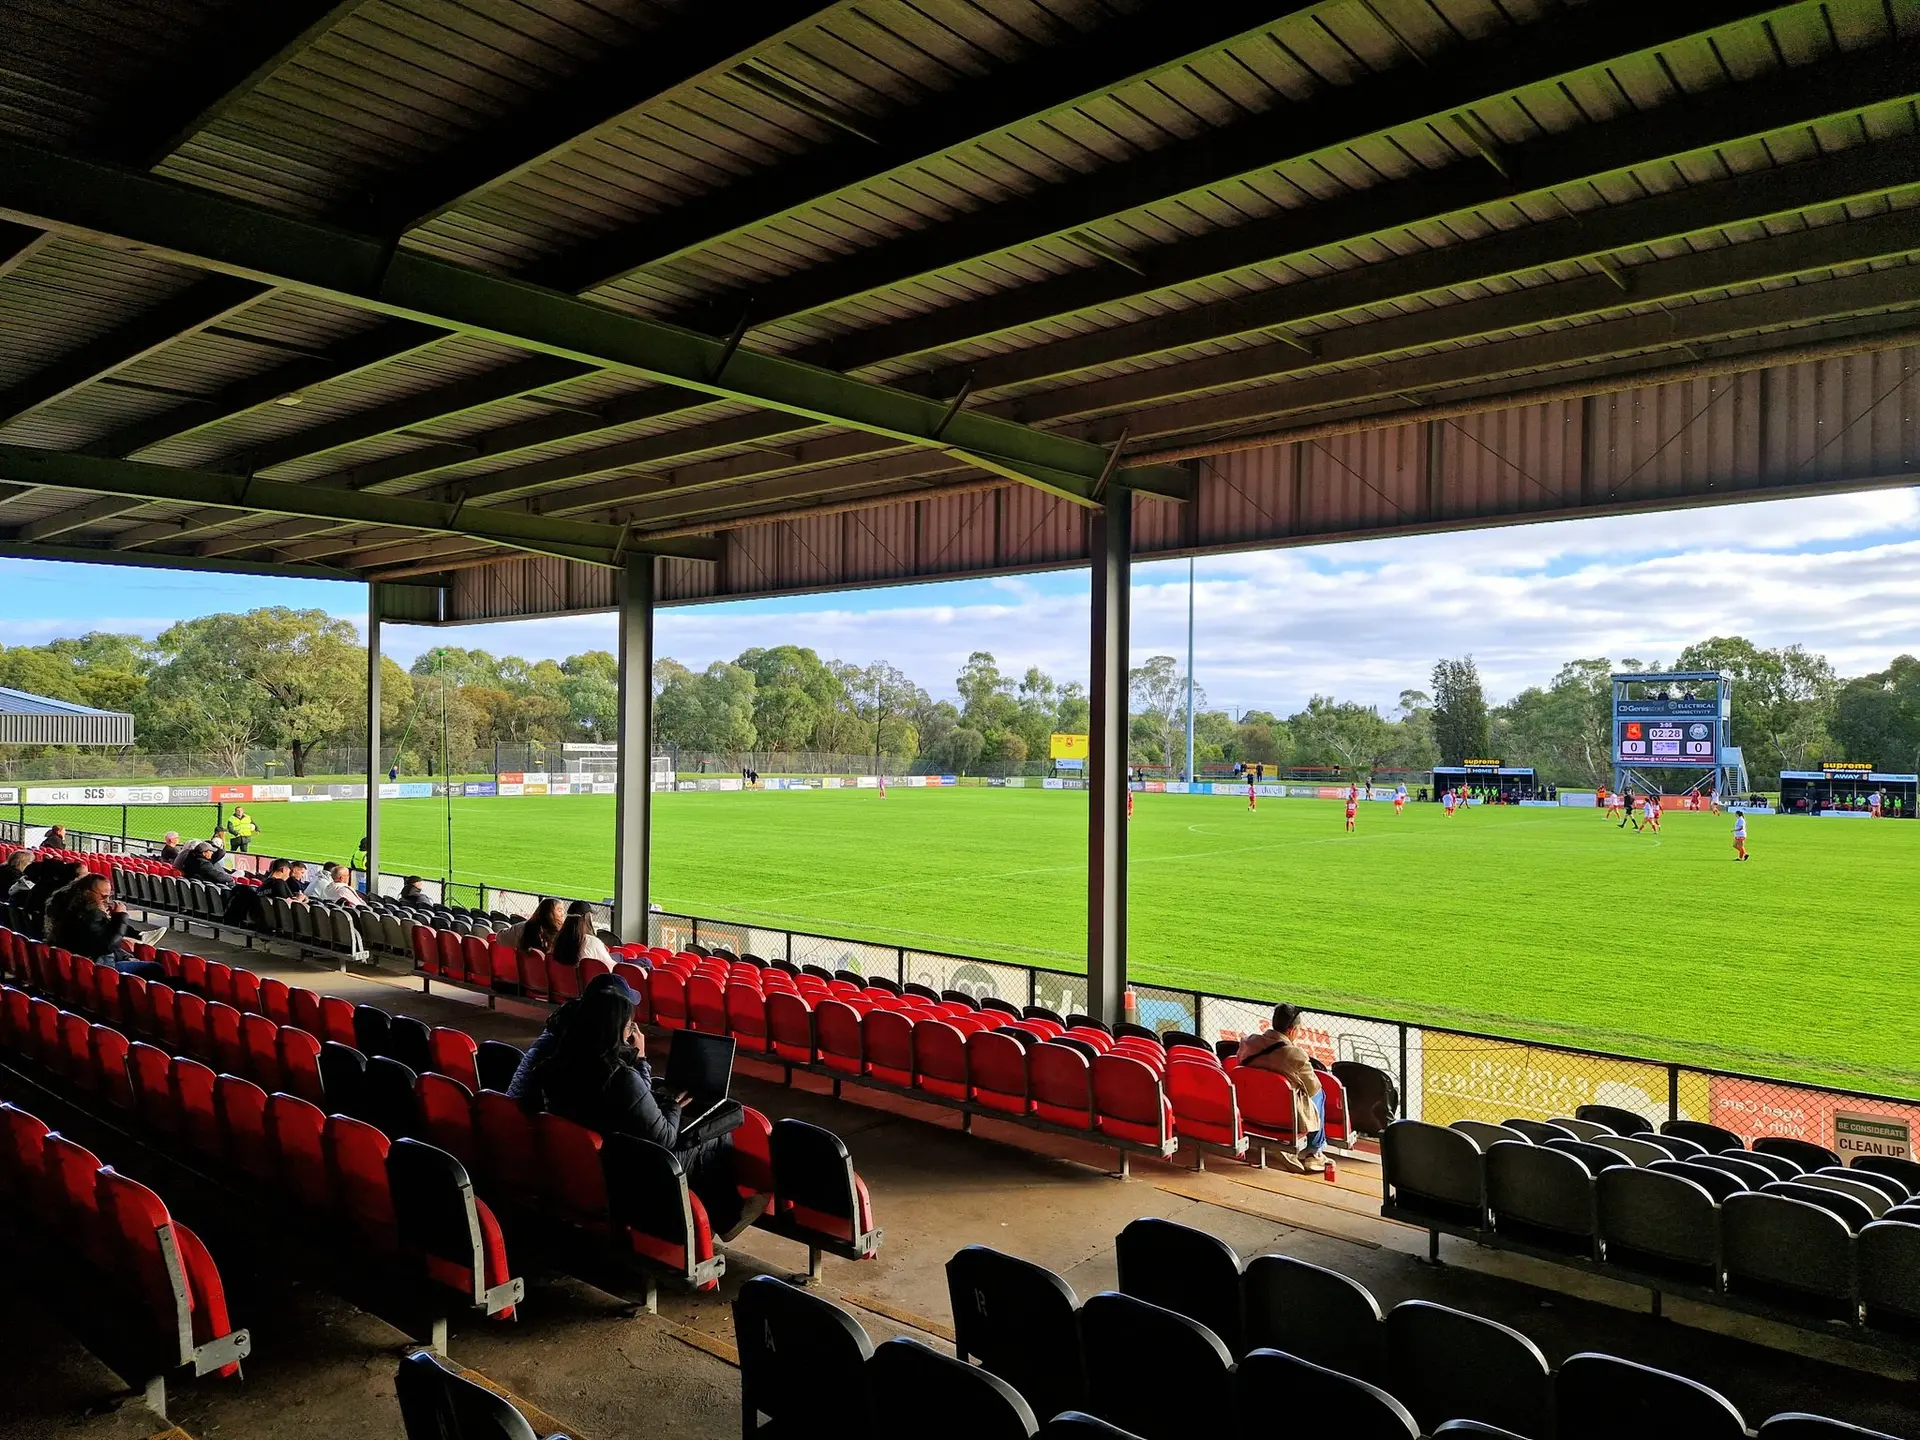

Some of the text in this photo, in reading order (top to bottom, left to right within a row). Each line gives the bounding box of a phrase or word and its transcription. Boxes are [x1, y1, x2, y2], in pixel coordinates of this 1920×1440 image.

[1652, 730, 1680, 738] 02:28
[1630, 742, 1638, 752] 0
[1694, 742, 1703, 753] 0
[84, 788, 105, 799] SCS
[1838, 1122, 1906, 1138] BE CONSIDERATE
[1840, 1138, 1905, 1157] CLEAN UP
